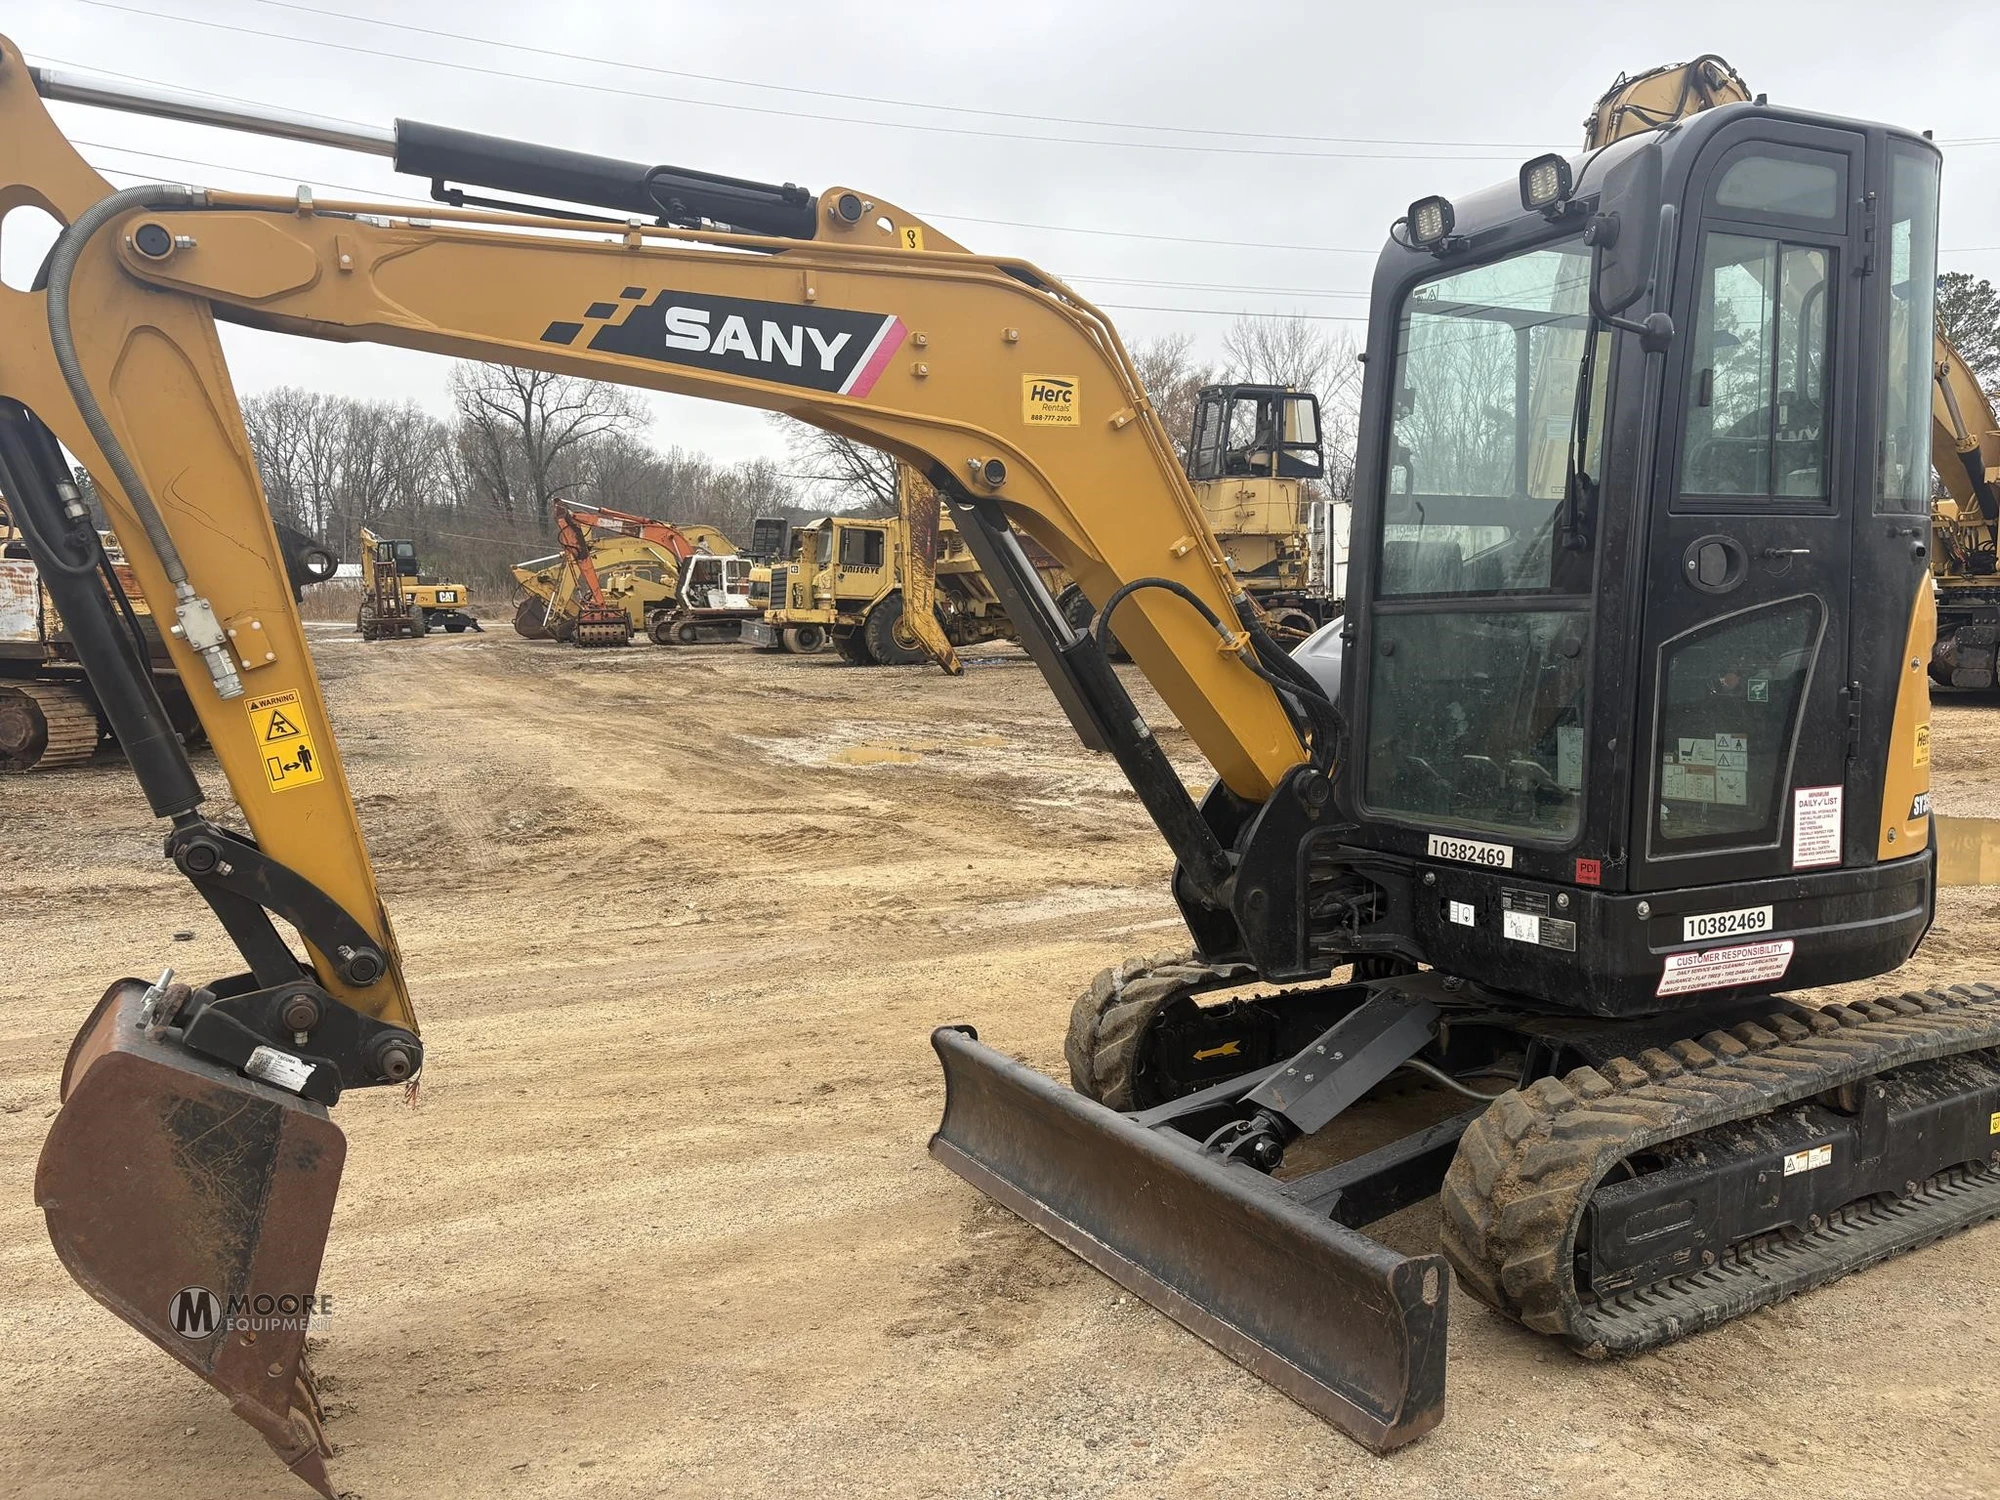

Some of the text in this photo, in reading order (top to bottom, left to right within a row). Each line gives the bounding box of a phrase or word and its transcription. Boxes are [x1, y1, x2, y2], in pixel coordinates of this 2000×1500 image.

[665, 306, 852, 372] SANY
[1031, 385, 1072, 403] Herc
[1042, 403, 1070, 412] Rentals
[1031, 414, 1072, 422] 888-777-2700
[842, 565, 880, 575] UNISERVE
[439, 592, 455, 602] CAT
[258, 693, 295, 708] WARNING
[1799, 797, 1837, 808] DAILY LIST
[1432, 839, 1505, 866] 10382469
[1580, 862, 1596, 874] PDI
[1688, 911, 1765, 937] 10382469
[1676, 944, 1782, 966] CUSTOMER RESPONSIBILITY
[1748, 957, 1778, 966] LUBRICATION
[1665, 977, 1692, 985] INSURANCE
